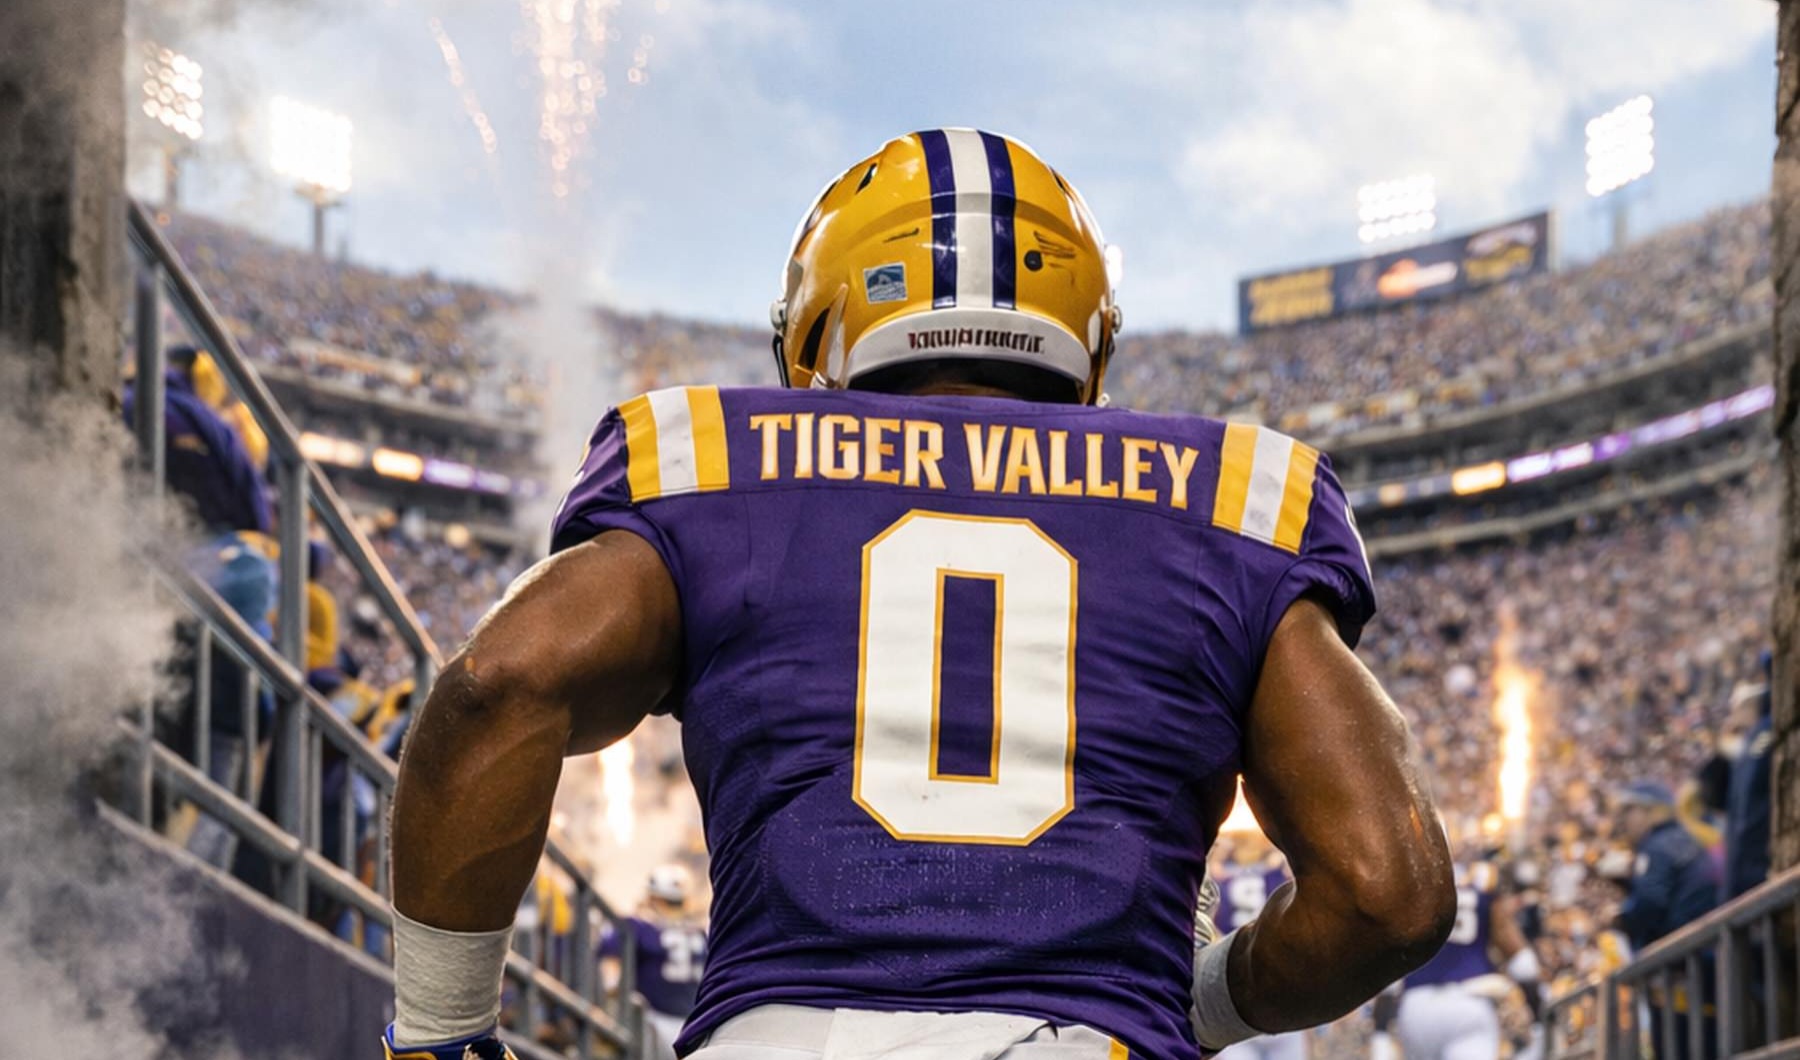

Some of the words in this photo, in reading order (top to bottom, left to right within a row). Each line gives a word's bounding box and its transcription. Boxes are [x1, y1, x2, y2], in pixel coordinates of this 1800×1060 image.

[750, 412, 946, 489] TIGER
[963, 423, 1200, 510] VALLEY
[851, 508, 1079, 847] 0
